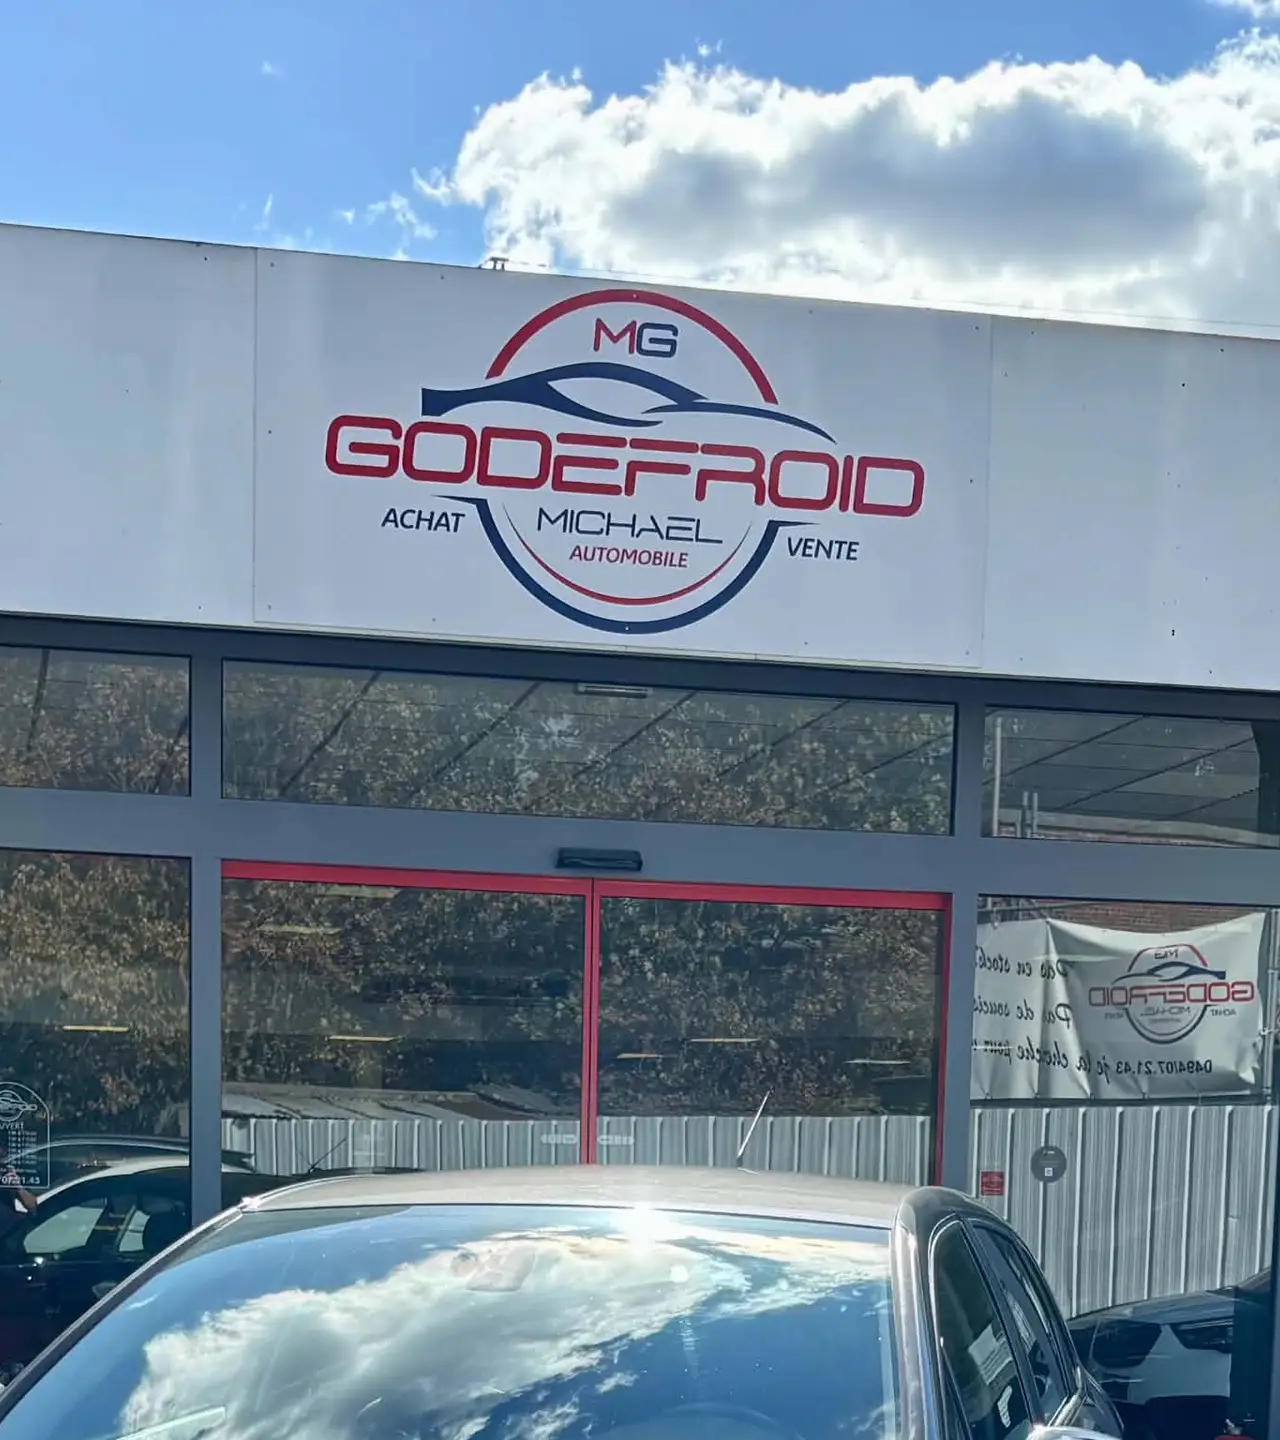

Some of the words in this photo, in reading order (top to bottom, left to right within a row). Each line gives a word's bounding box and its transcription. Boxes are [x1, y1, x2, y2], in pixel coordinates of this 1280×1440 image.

[593, 318, 678, 358] MG
[326, 414, 925, 518] GODEFROID
[381, 507, 466, 533] ACHAT
[537, 507, 722, 544] MICHAEL
[569, 545, 688, 568] AUTOMOBILE
[786, 536, 859, 562] VENTE
